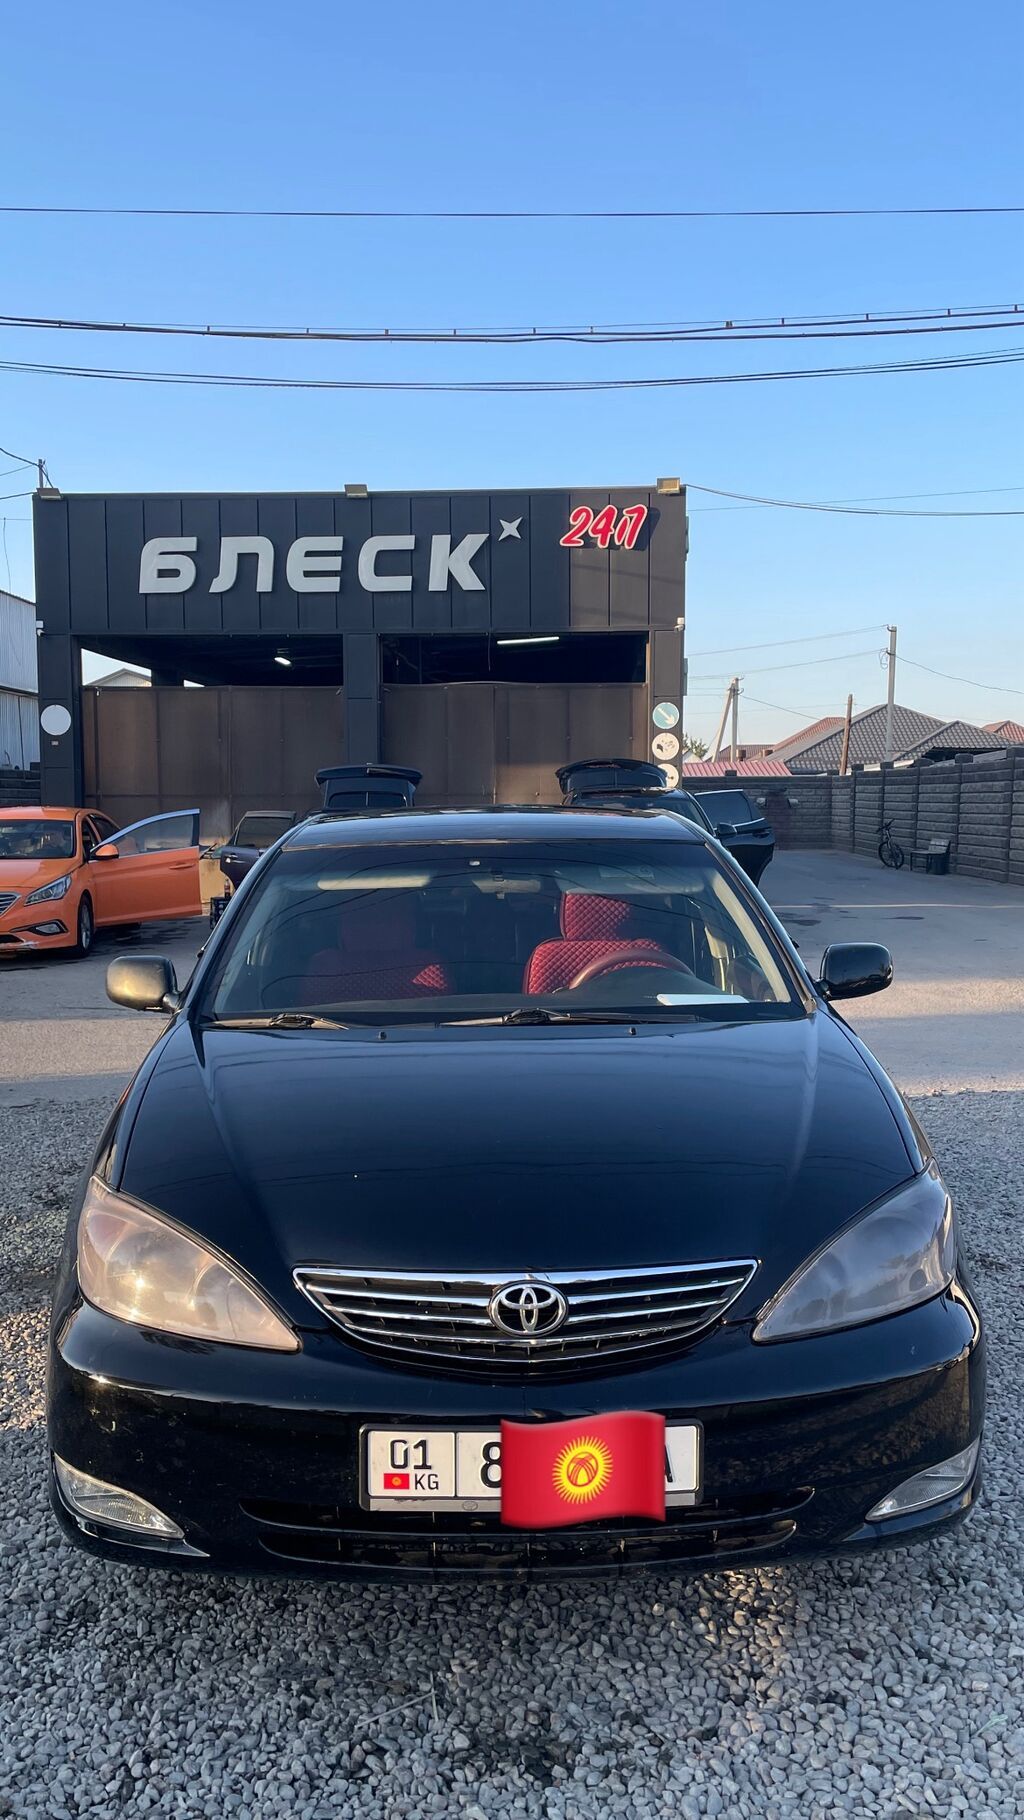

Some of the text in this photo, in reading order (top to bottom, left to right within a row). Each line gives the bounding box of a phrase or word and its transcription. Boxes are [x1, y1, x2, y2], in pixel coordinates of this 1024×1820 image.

[139, 533, 490, 594] БЛЕСК
[390, 1439, 432, 1469] 01
[415, 1473, 439, 1490] KG
